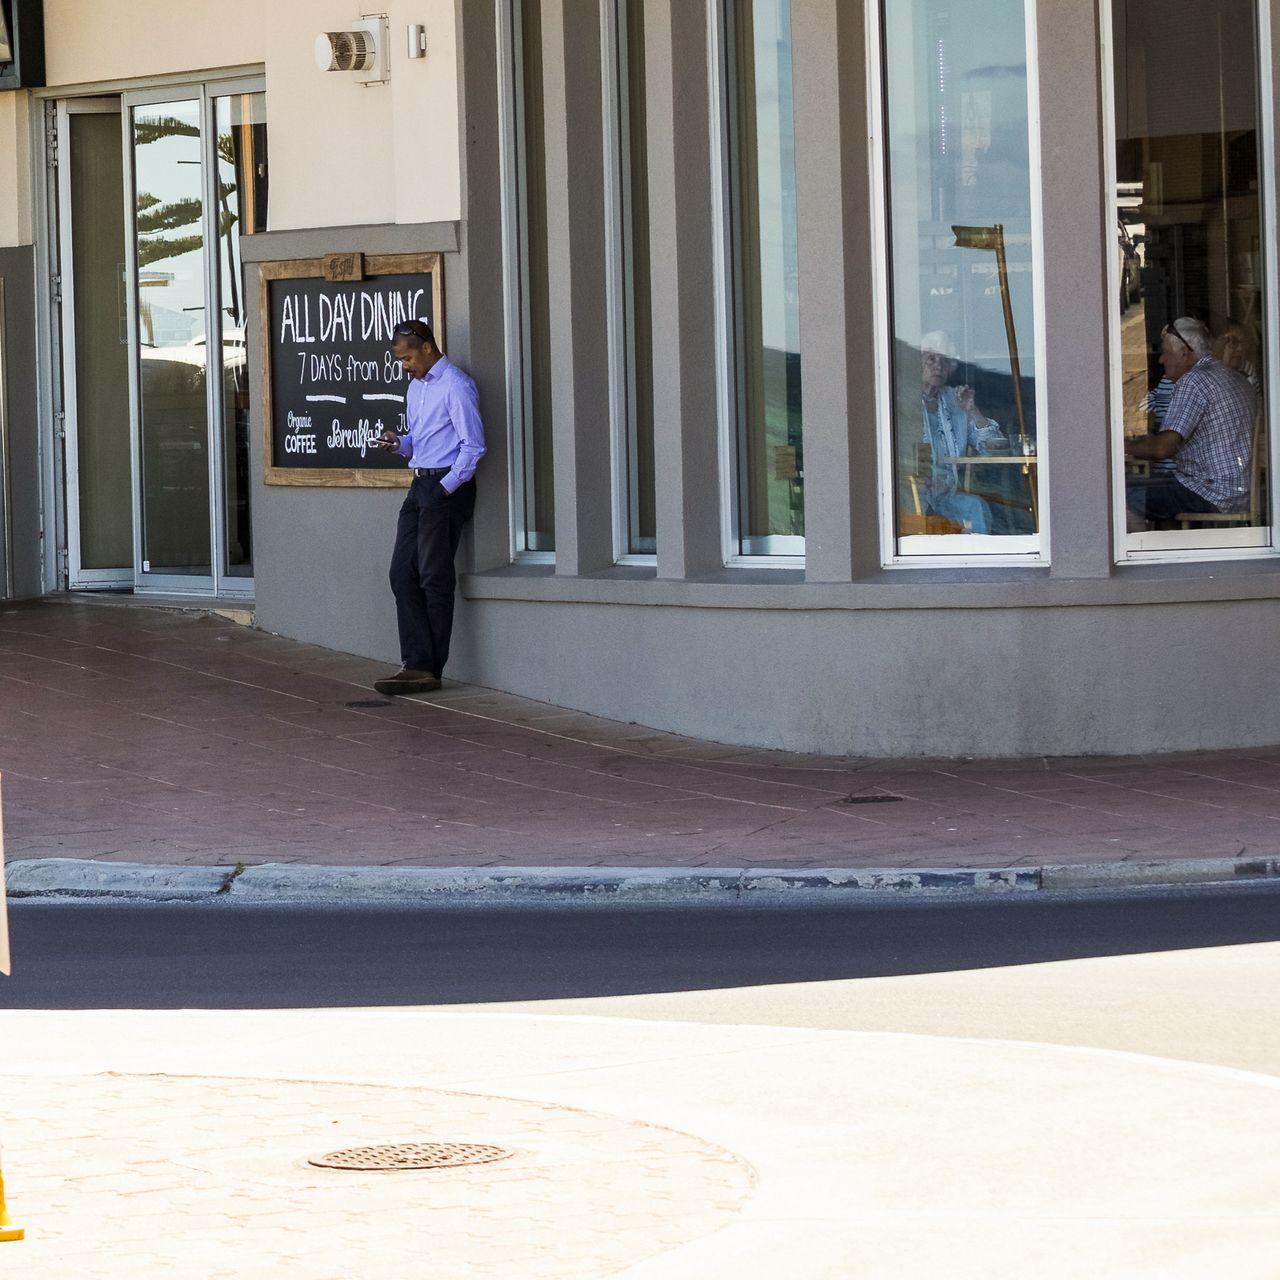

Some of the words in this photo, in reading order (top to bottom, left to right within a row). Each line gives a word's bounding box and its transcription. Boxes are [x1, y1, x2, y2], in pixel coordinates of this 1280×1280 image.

[281, 295, 315, 343] ALL
[319, 292, 355, 342] DAY
[298, 352, 306, 384] 7
[311, 354, 342, 382] DAYS
[346, 354, 379, 382] from
[287, 410, 312, 434] Organic
[285, 434, 317, 454] COFFEE
